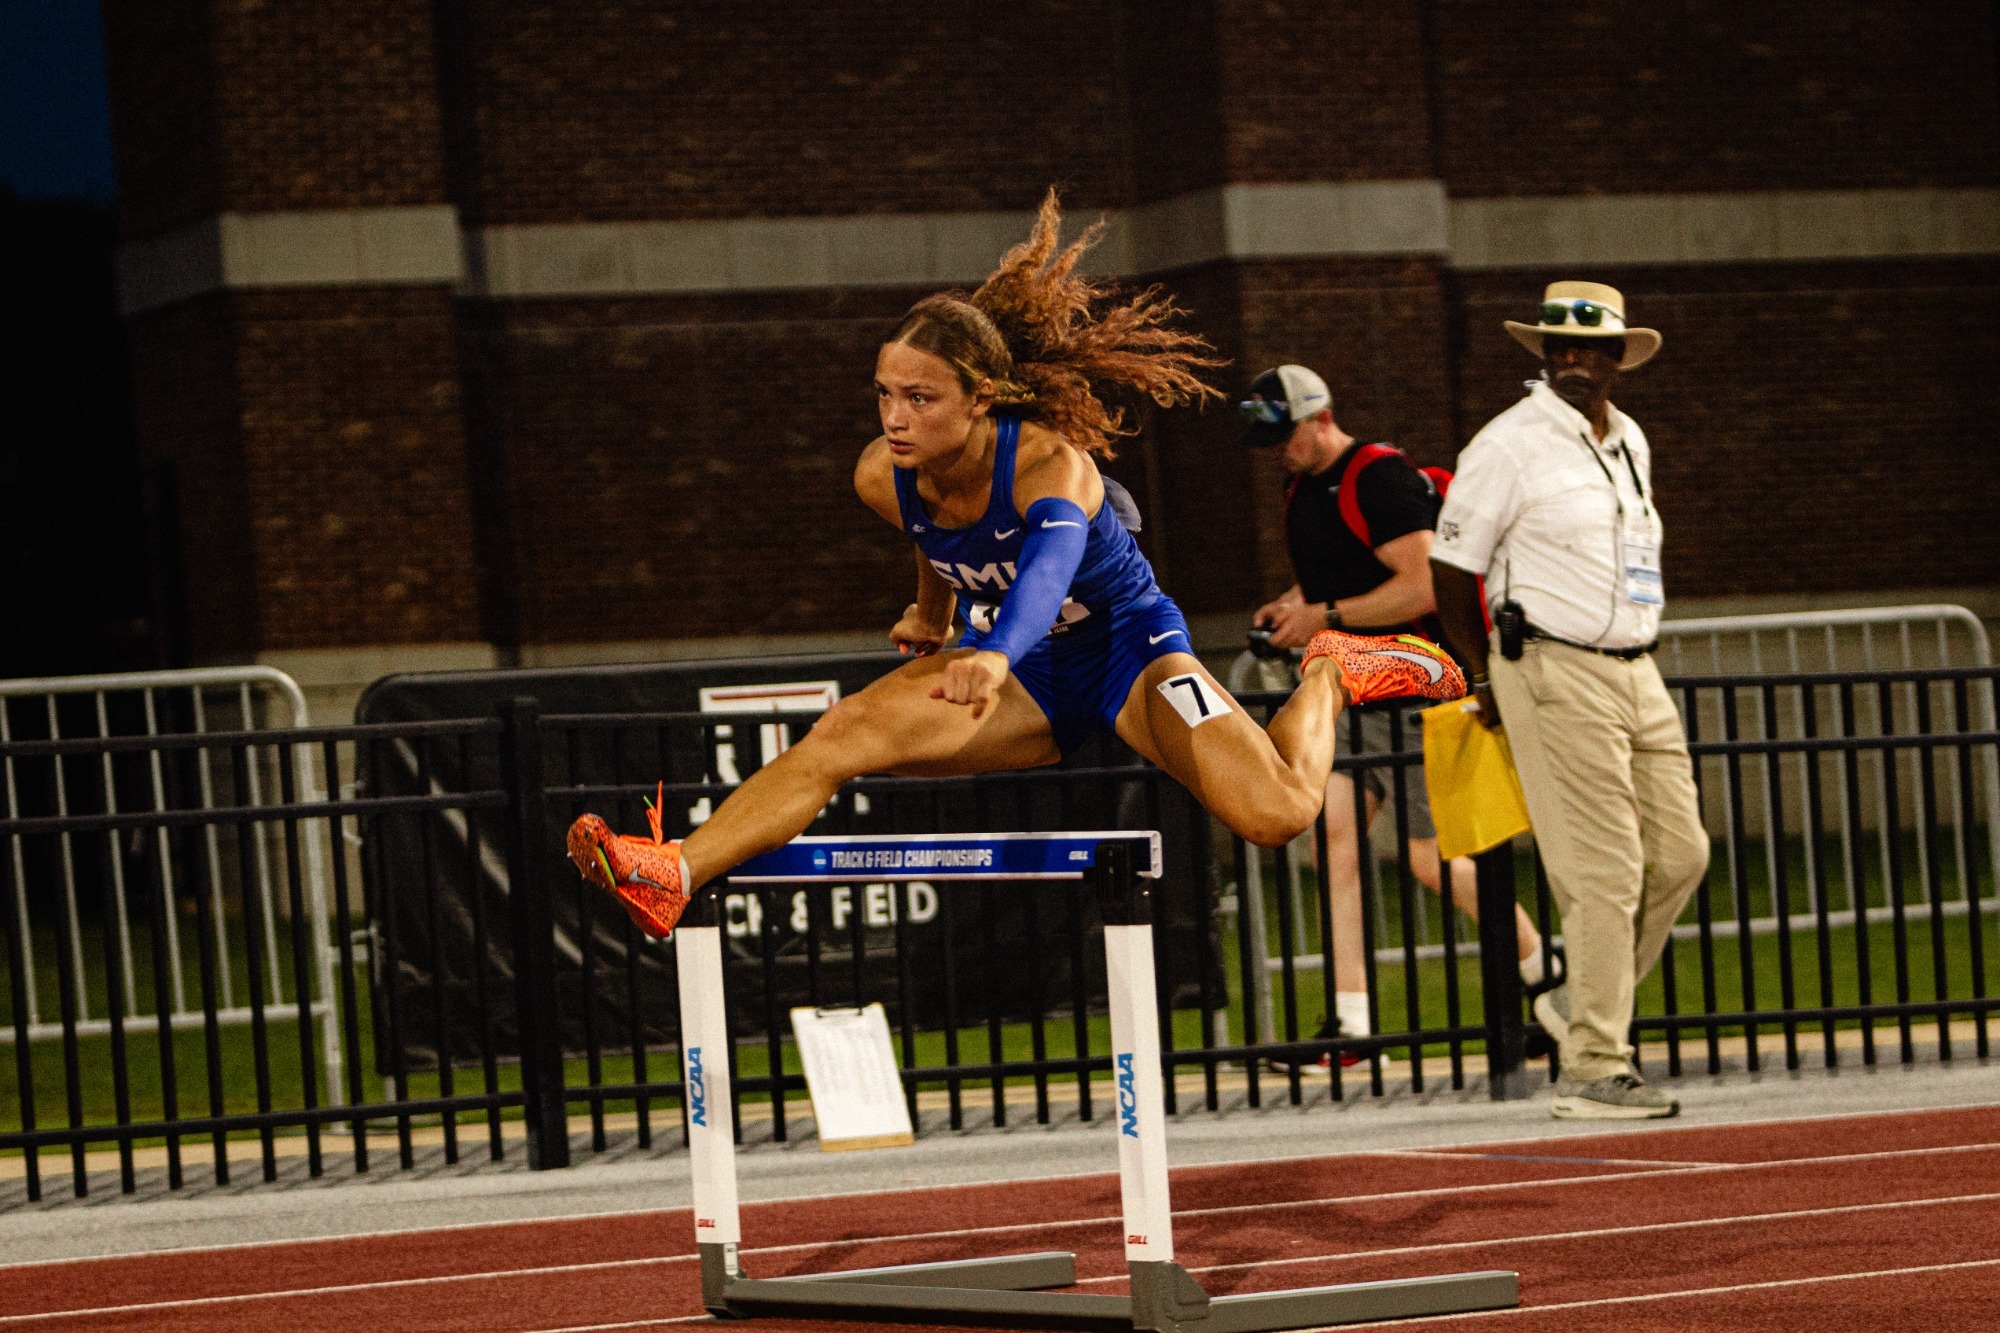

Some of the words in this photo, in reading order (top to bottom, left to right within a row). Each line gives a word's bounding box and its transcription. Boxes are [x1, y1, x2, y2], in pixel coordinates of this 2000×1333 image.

[1168, 676, 1210, 718] 7
[831, 851, 864, 868] TRACK
[875, 850, 903, 868] FIELD
[904, 849, 993, 867] CHAMPIONSHIPS
[688, 1046, 707, 1127] NCAA
[1117, 1053, 1139, 1139] NCAA
[1127, 1234, 1149, 1245] GILL
